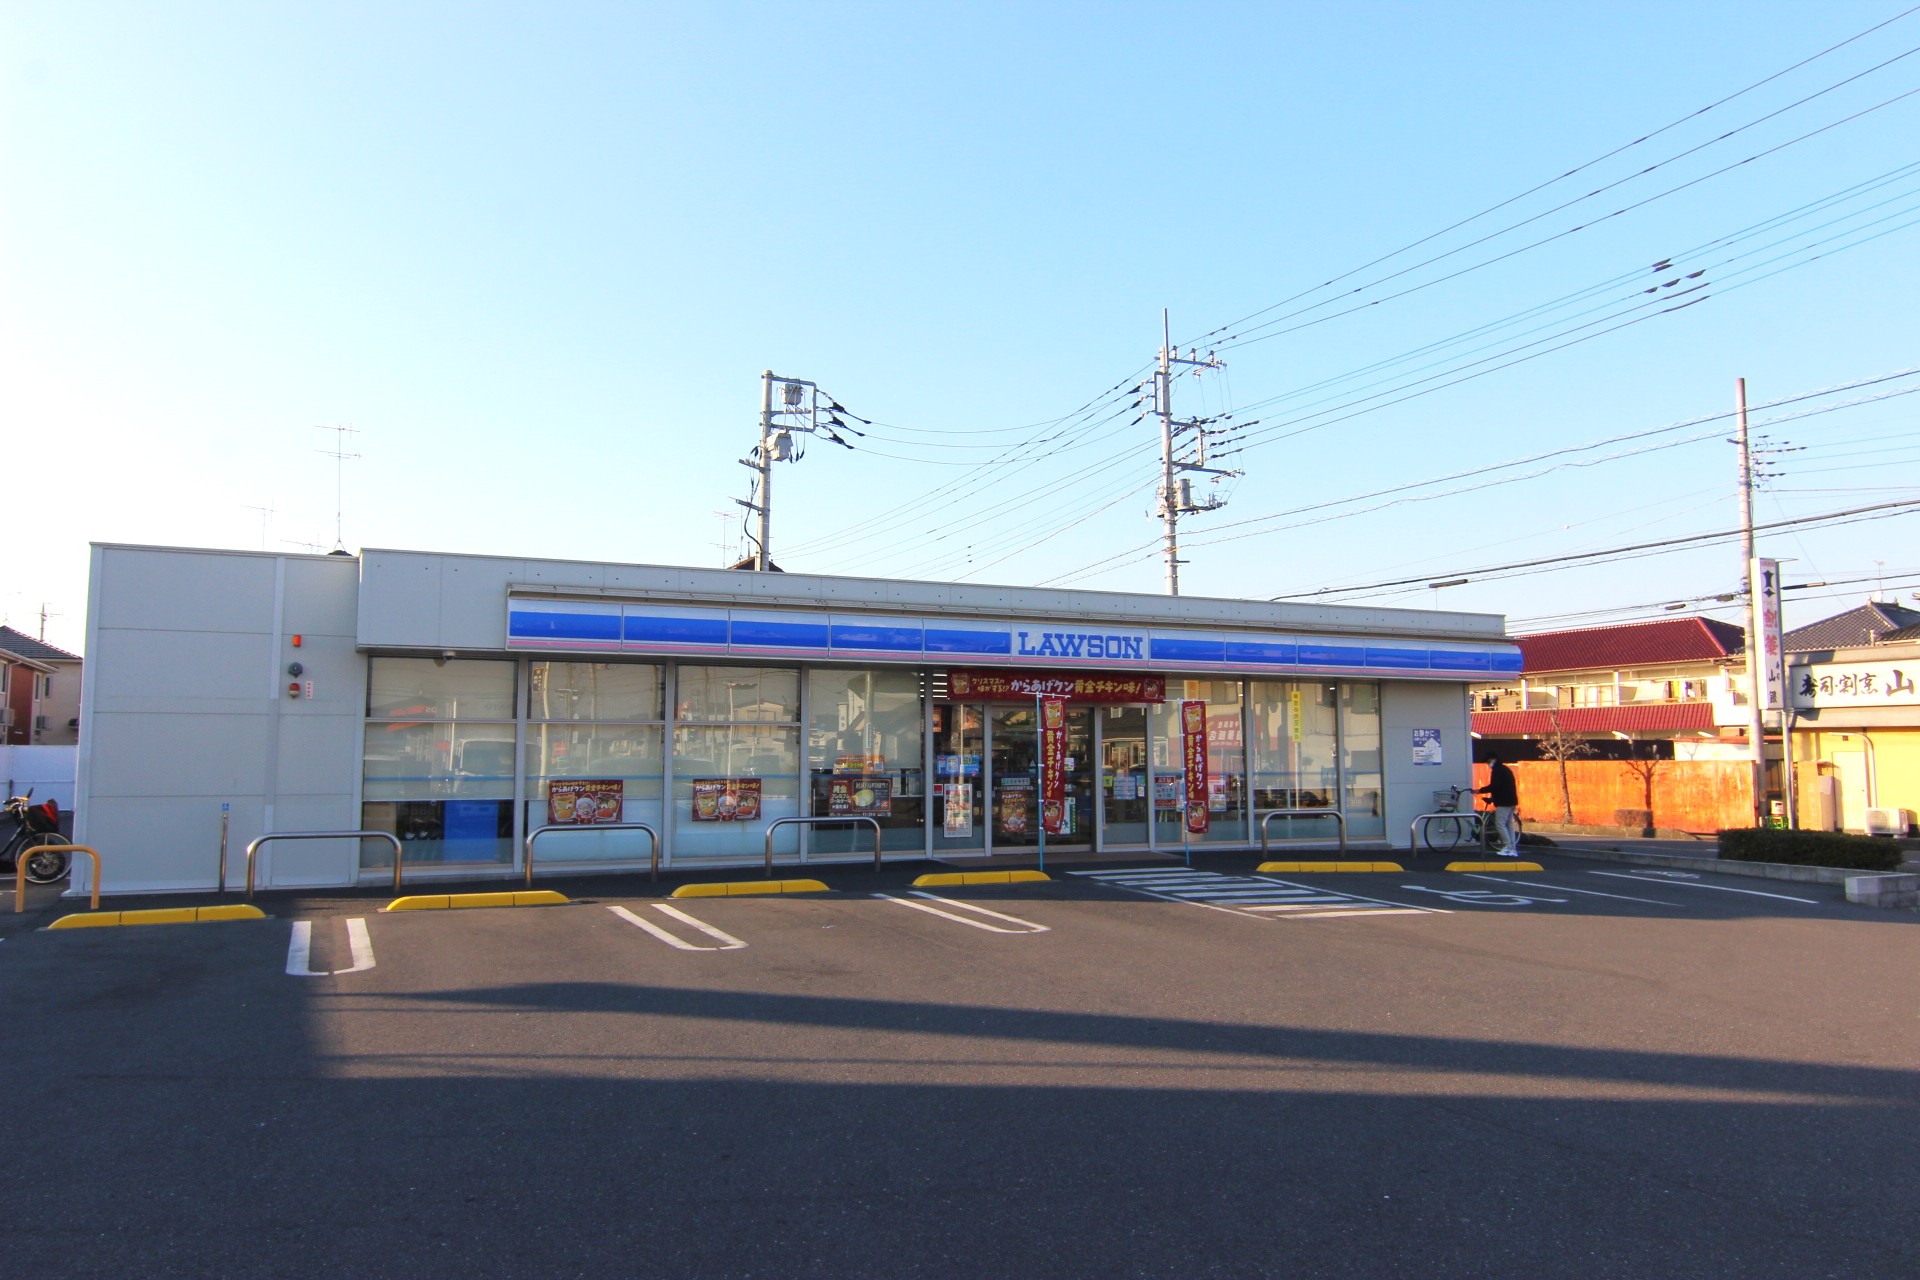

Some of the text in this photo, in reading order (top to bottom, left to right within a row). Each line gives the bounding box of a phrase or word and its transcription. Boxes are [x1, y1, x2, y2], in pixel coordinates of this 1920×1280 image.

[1018, 631, 1143, 659] LAWSON
[972, 677, 1005, 685] クリスマスの
[1010, 678, 1142, 694] からあげクン 黄金チキン味!
[1885, 669, 1915, 697] 山
[1054, 730, 1063, 788] からあげクン
[1195, 733, 1204, 790] からあげクン
[551, 785, 585, 793] からあげクン
